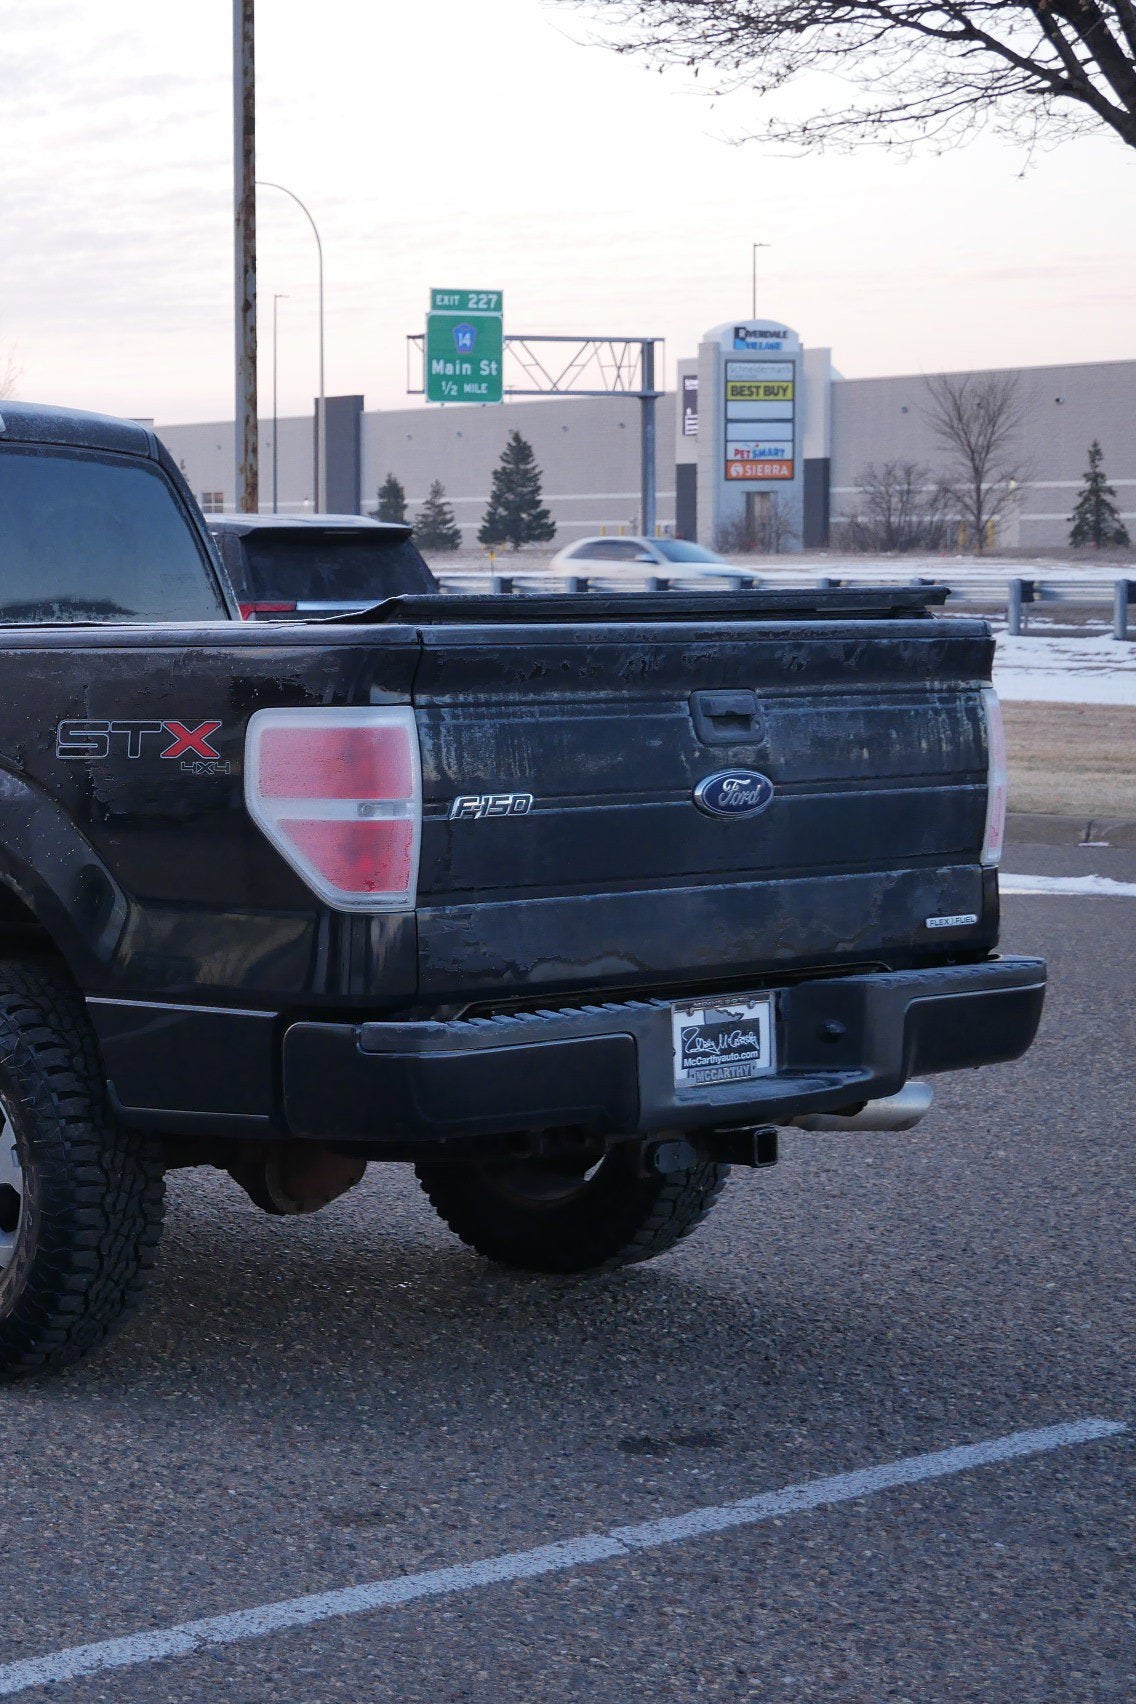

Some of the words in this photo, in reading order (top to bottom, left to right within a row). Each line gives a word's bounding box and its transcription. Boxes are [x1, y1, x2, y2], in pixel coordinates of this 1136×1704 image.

[436, 295, 459, 305] EXIT
[468, 293, 498, 309] 227
[458, 333, 471, 347] 14
[432, 360, 472, 375] Main
[480, 360, 498, 375] St
[464, 383, 488, 394] MILE
[730, 385, 761, 397] BEST
[764, 385, 789, 397] BUY
[745, 464, 789, 476] SIERRA
[56, 719, 222, 759] STX
[719, 778, 761, 806] Ford
[929, 919, 950, 927] FLEX
[955, 916, 976, 924] FUEL
[683, 1050, 759, 1067] McCarthyauto.com
[696, 1064, 751, 1083] MCCARTHY
